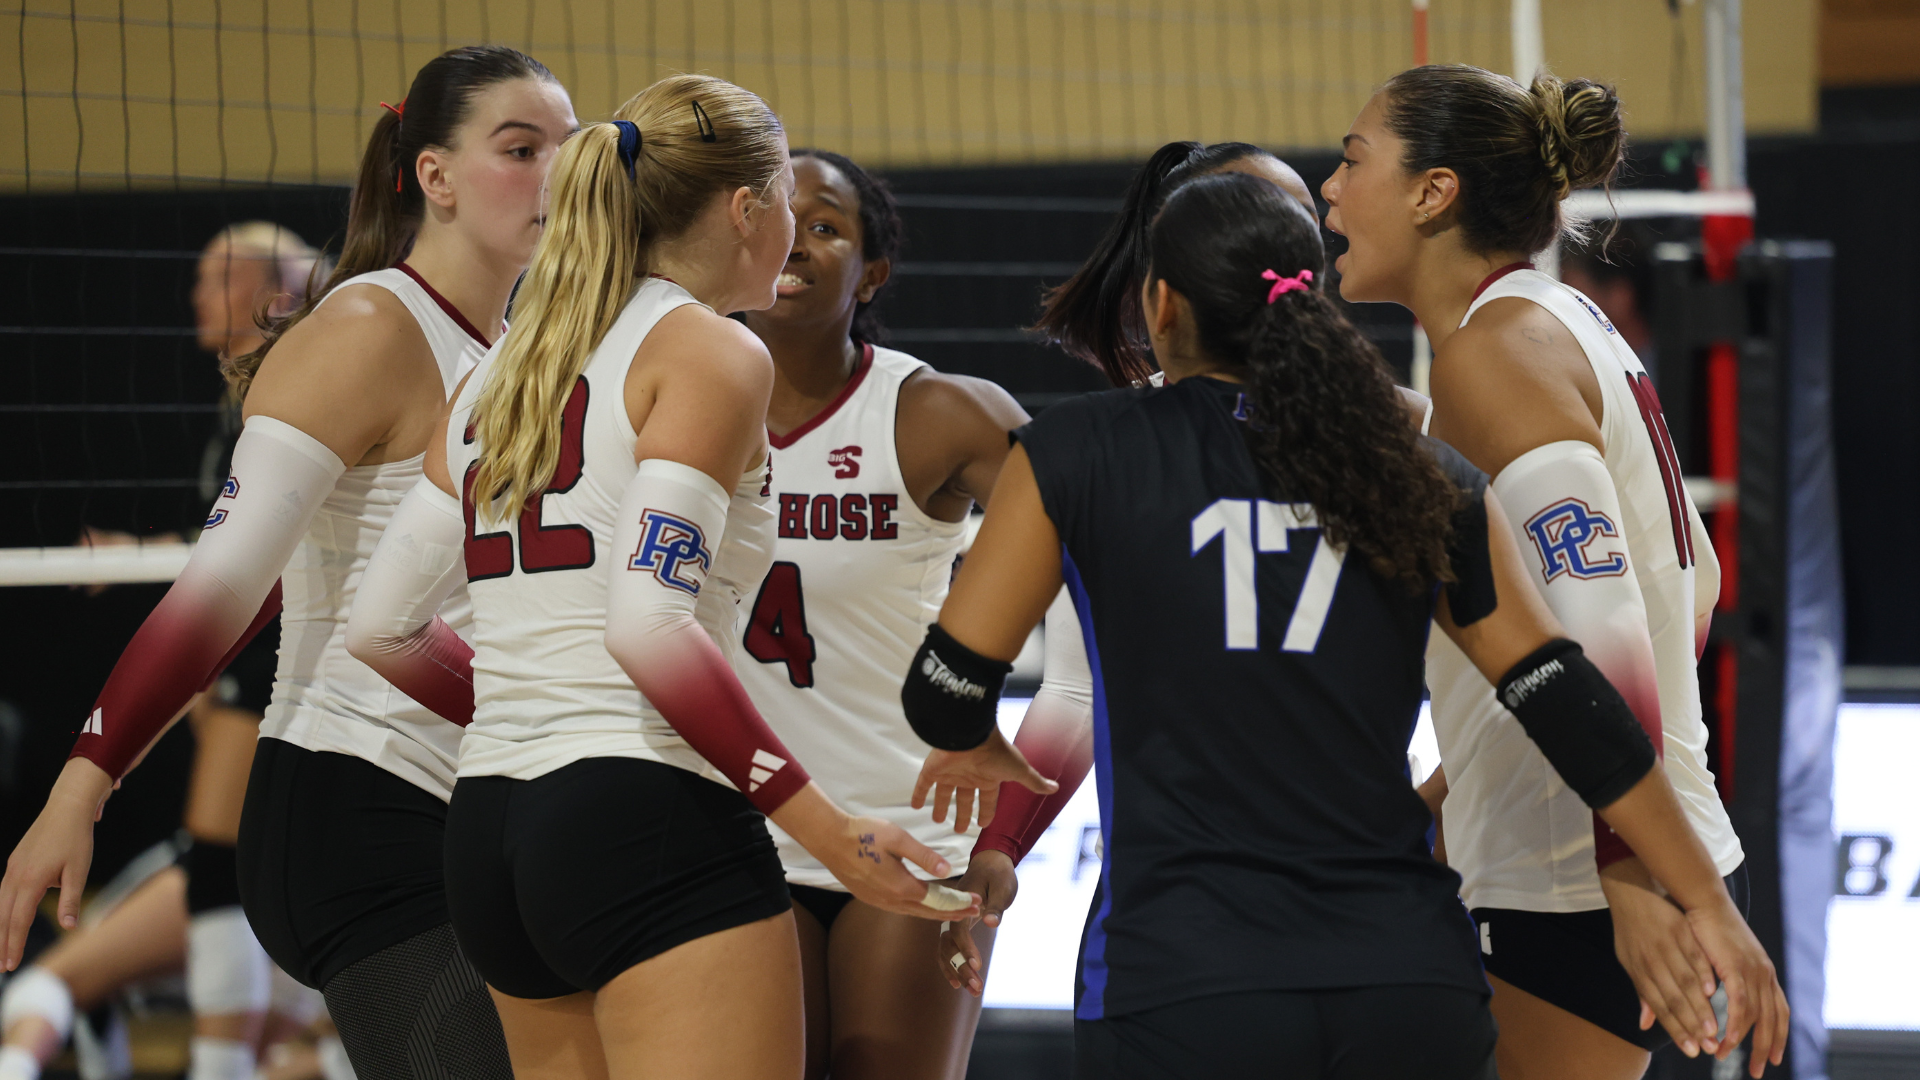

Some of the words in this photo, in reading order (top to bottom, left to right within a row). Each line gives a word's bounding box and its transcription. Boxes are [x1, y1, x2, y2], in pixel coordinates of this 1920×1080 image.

[463, 374, 596, 583] 22
[778, 493, 898, 541] HOSE
[627, 508, 713, 598] PC
[1191, 497, 1349, 653] 17
[1523, 497, 1628, 585] PC
[743, 560, 816, 688] 4
[928, 650, 987, 699] Tandem
[1835, 834, 1920, 897] B
